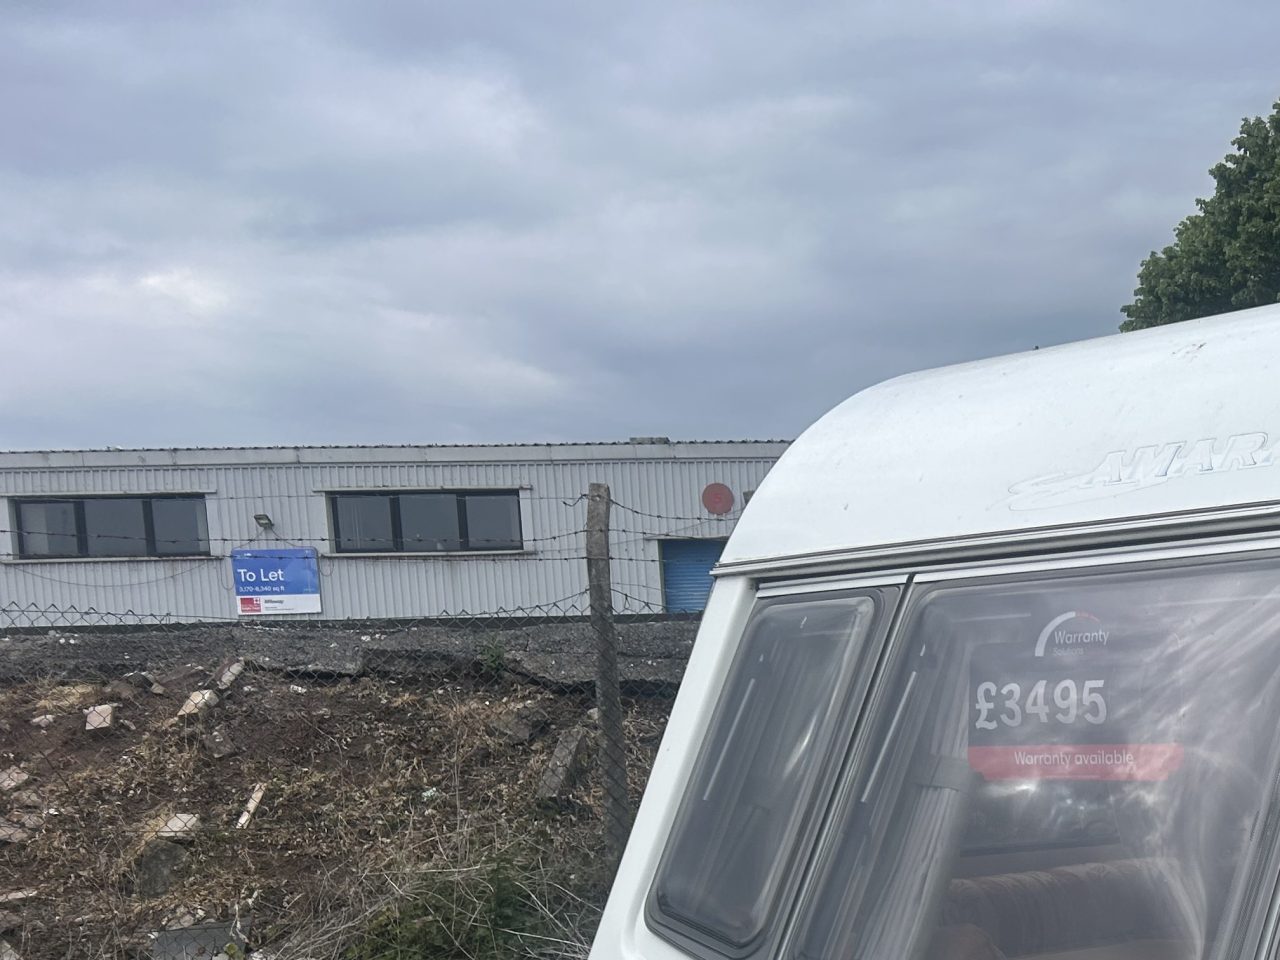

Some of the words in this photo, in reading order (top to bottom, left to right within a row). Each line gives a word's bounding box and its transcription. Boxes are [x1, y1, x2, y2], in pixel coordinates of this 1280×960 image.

[237, 568, 256, 582] To
[260, 568, 284, 582] Let
[1054, 629, 1109, 646] Warranty
[975, 679, 1107, 730] £3495
[1014, 750, 1071, 769] Warranty
[1074, 749, 1134, 766] available
